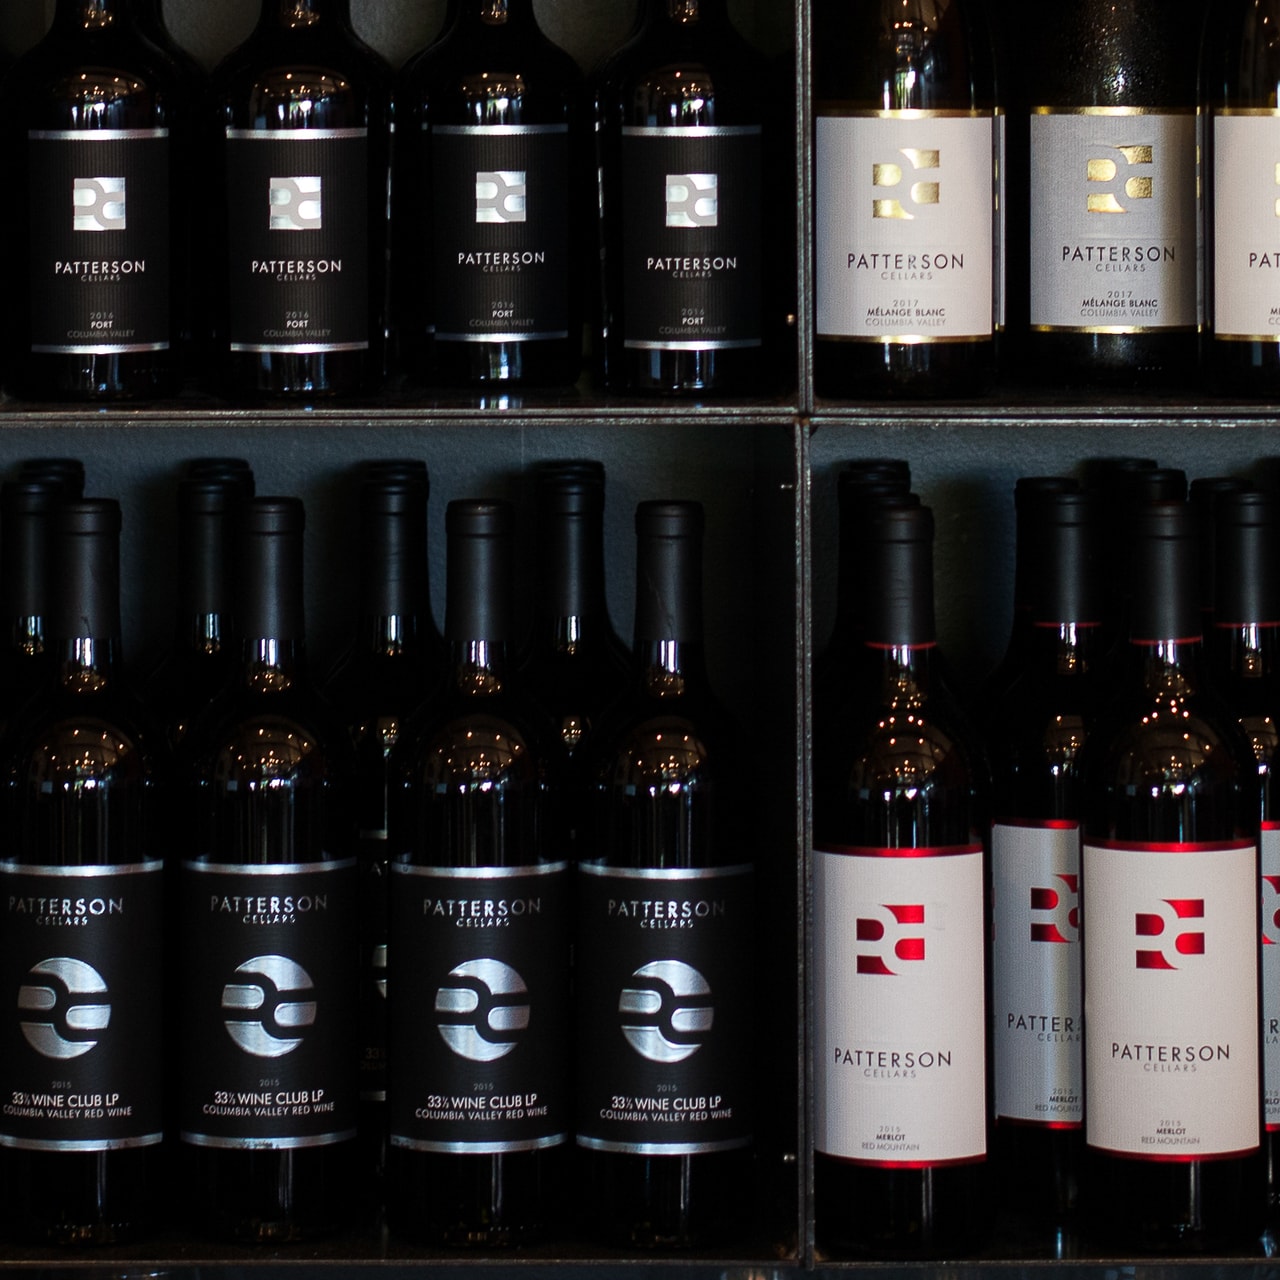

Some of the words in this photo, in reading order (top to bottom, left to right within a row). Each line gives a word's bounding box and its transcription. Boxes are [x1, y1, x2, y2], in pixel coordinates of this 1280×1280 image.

[458, 252, 544, 265] PATTERSON
[1062, 246, 1175, 262] PATTERSON
[252, 260, 341, 273] PATTERSON
[648, 257, 736, 270] PATTERSON
[847, 253, 963, 269] PATTERSON
[55, 261, 144, 274] PATTERSON
[1096, 264, 1146, 272] CELLARS
[881, 272, 932, 281] CELLARS
[1082, 298, 1125, 308] MÉLANGE
[1129, 300, 1157, 308] BLANC
[492, 310, 513, 318] PORT
[915, 309, 945, 317] BLANC
[91, 321, 113, 329] PORT
[287, 320, 308, 328] PORT
[682, 317, 703, 325] PORT
[9, 897, 123, 915] PATTERSON
[211, 895, 327, 914] PATTERSON
[424, 898, 540, 916] PATTERSON
[608, 900, 725, 918] PATTERSON
[834, 1047, 951, 1068] PATTERSON
[1112, 1042, 1229, 1063] PATTERSON
[864, 1068, 917, 1079] CELLARS
[1144, 1063, 1197, 1073] CELLARS
[876, 1133, 905, 1142] MERLOT
[1156, 1127, 1186, 1136] MERLOT
